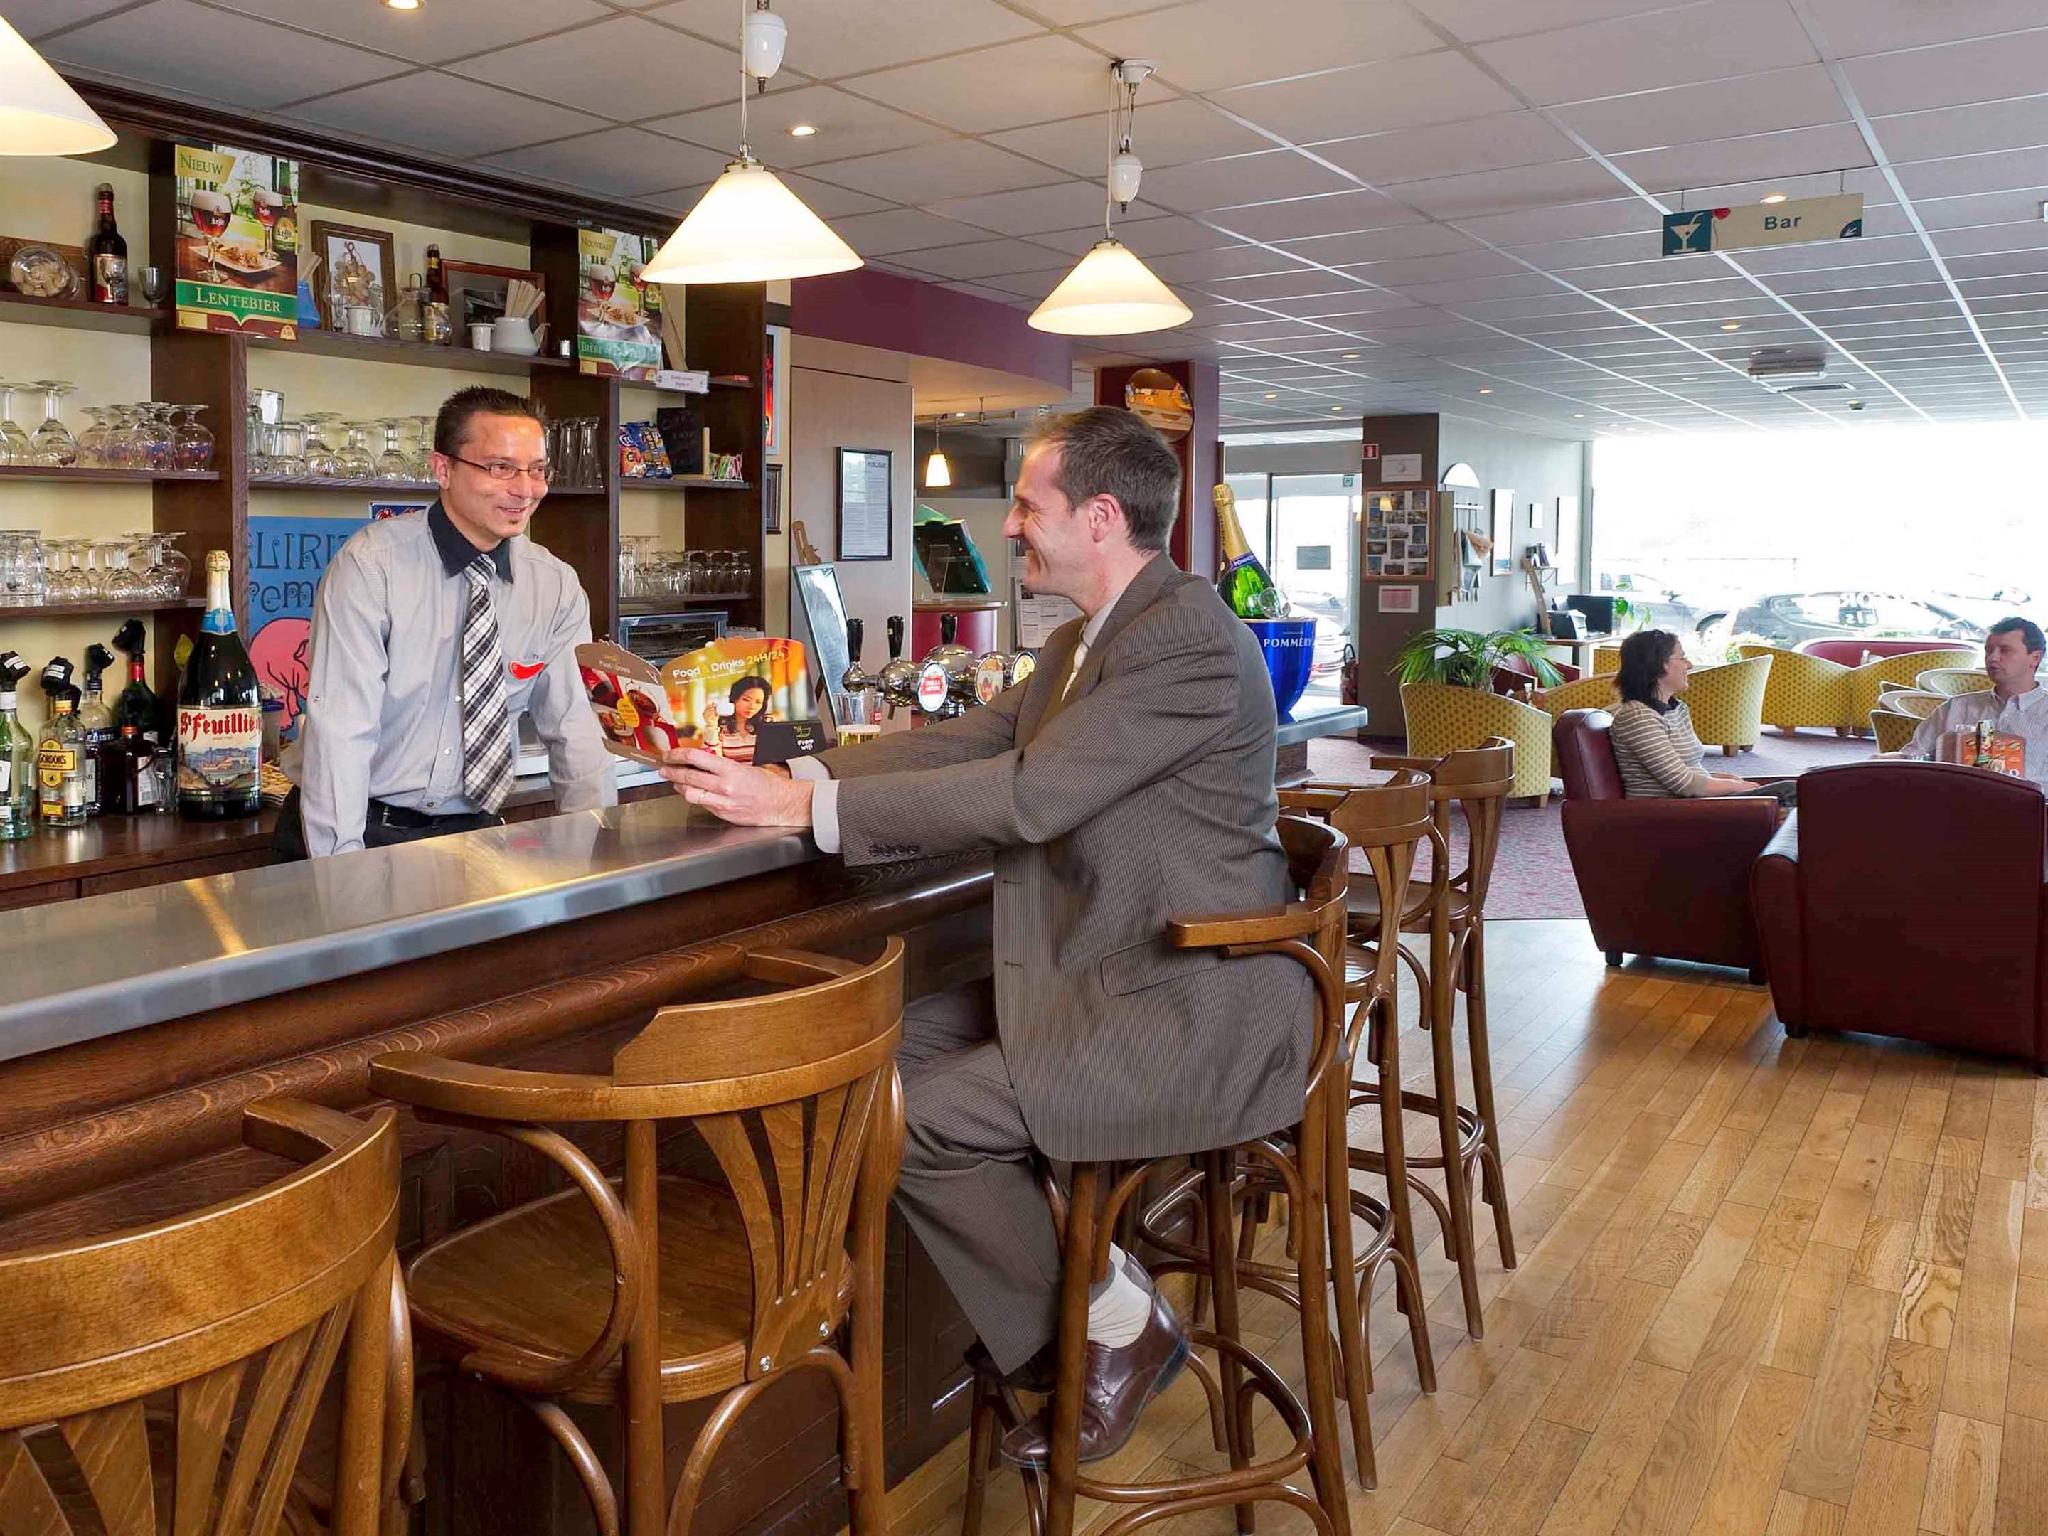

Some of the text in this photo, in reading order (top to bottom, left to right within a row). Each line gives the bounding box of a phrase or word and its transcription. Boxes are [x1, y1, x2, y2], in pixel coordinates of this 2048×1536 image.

[180, 154, 223, 175] NIEUW
[1764, 214, 1802, 231] Bar
[196, 287, 281, 312] LENTEBIER
[672, 666, 701, 679] Food
[711, 658, 745, 673] Drinks
